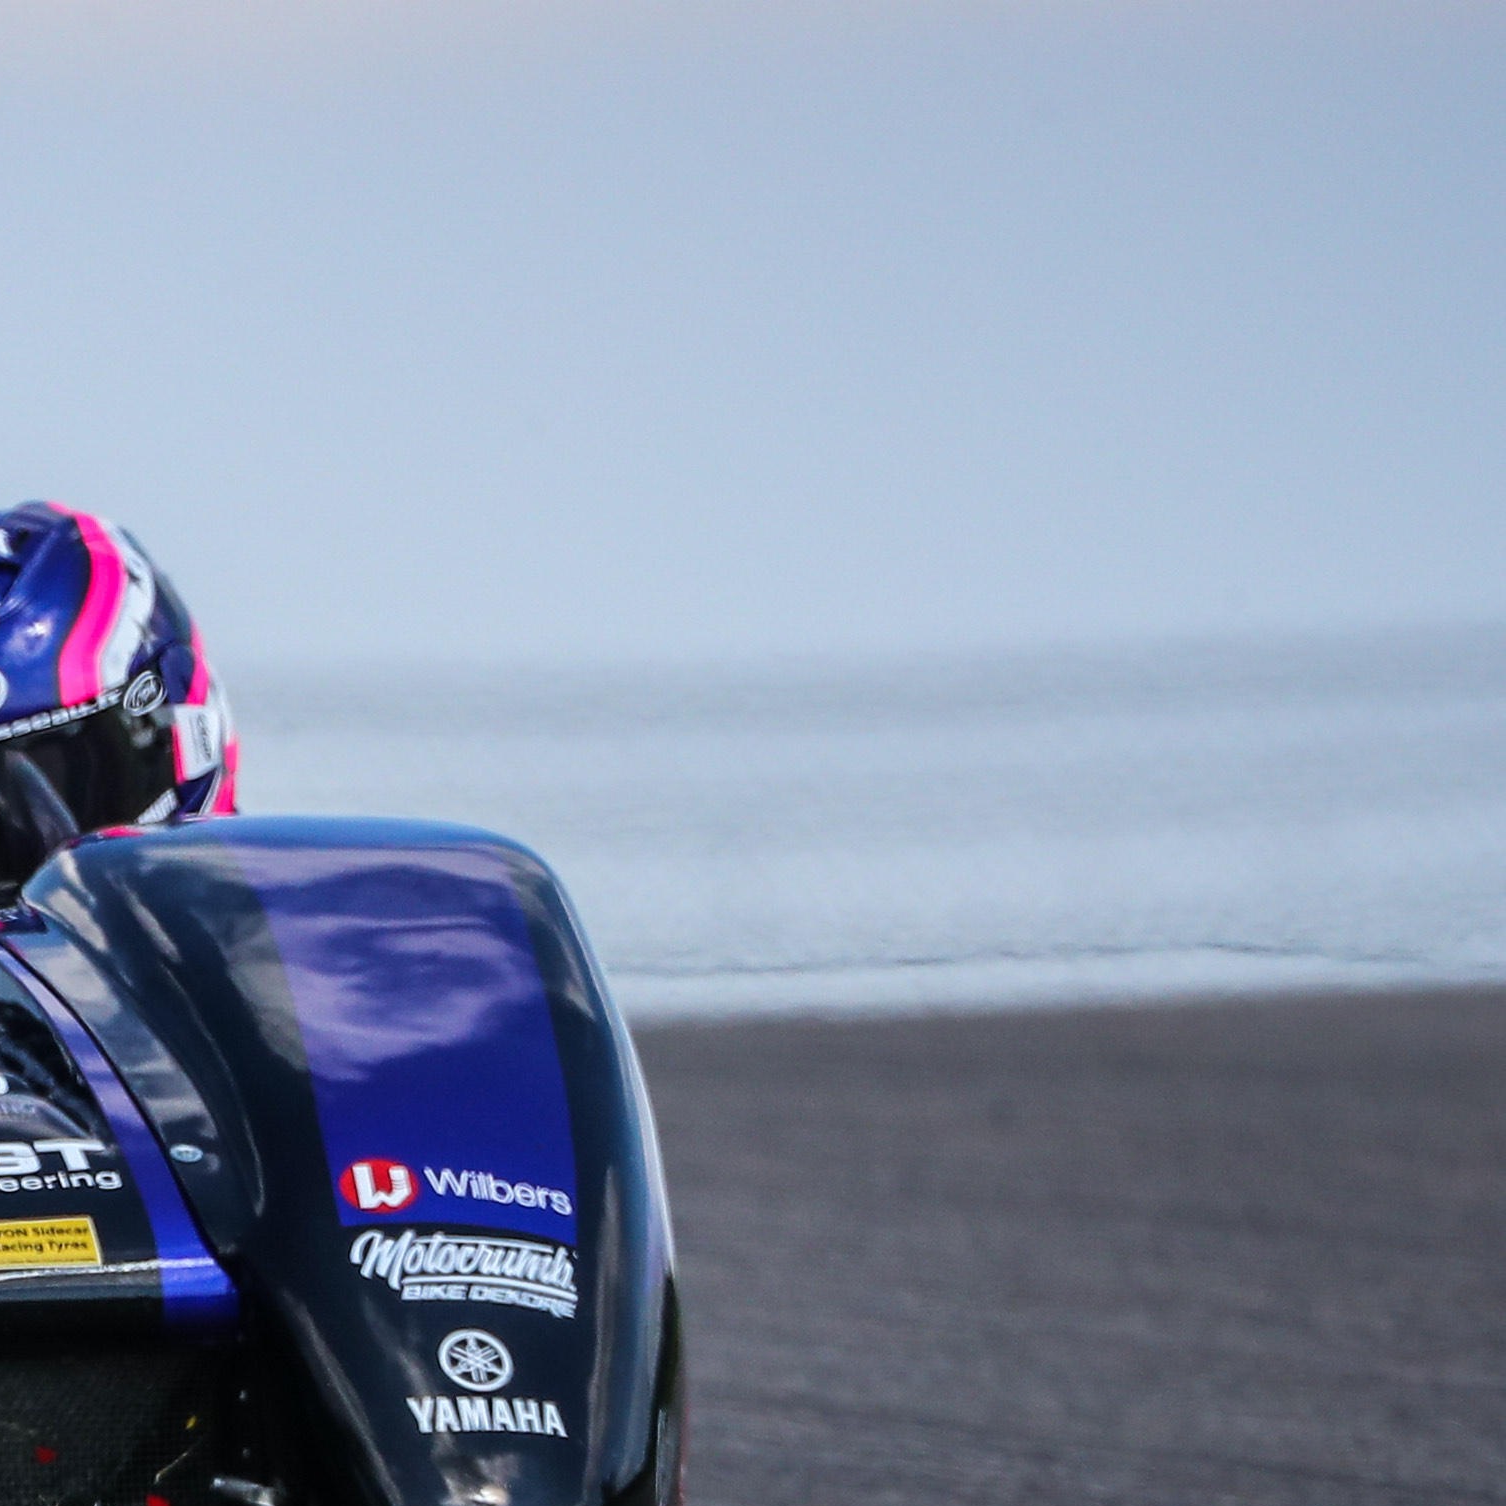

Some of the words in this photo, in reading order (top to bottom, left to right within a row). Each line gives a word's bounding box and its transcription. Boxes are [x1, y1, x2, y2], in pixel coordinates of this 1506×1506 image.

[422, 1166, 573, 1216] Wilbers
[31, 1226, 89, 1237] Sidecar
[47, 1240, 88, 1251] Tyres
[400, 1284, 468, 1301] BIKE
[405, 1396, 569, 1439] YAMAHA
